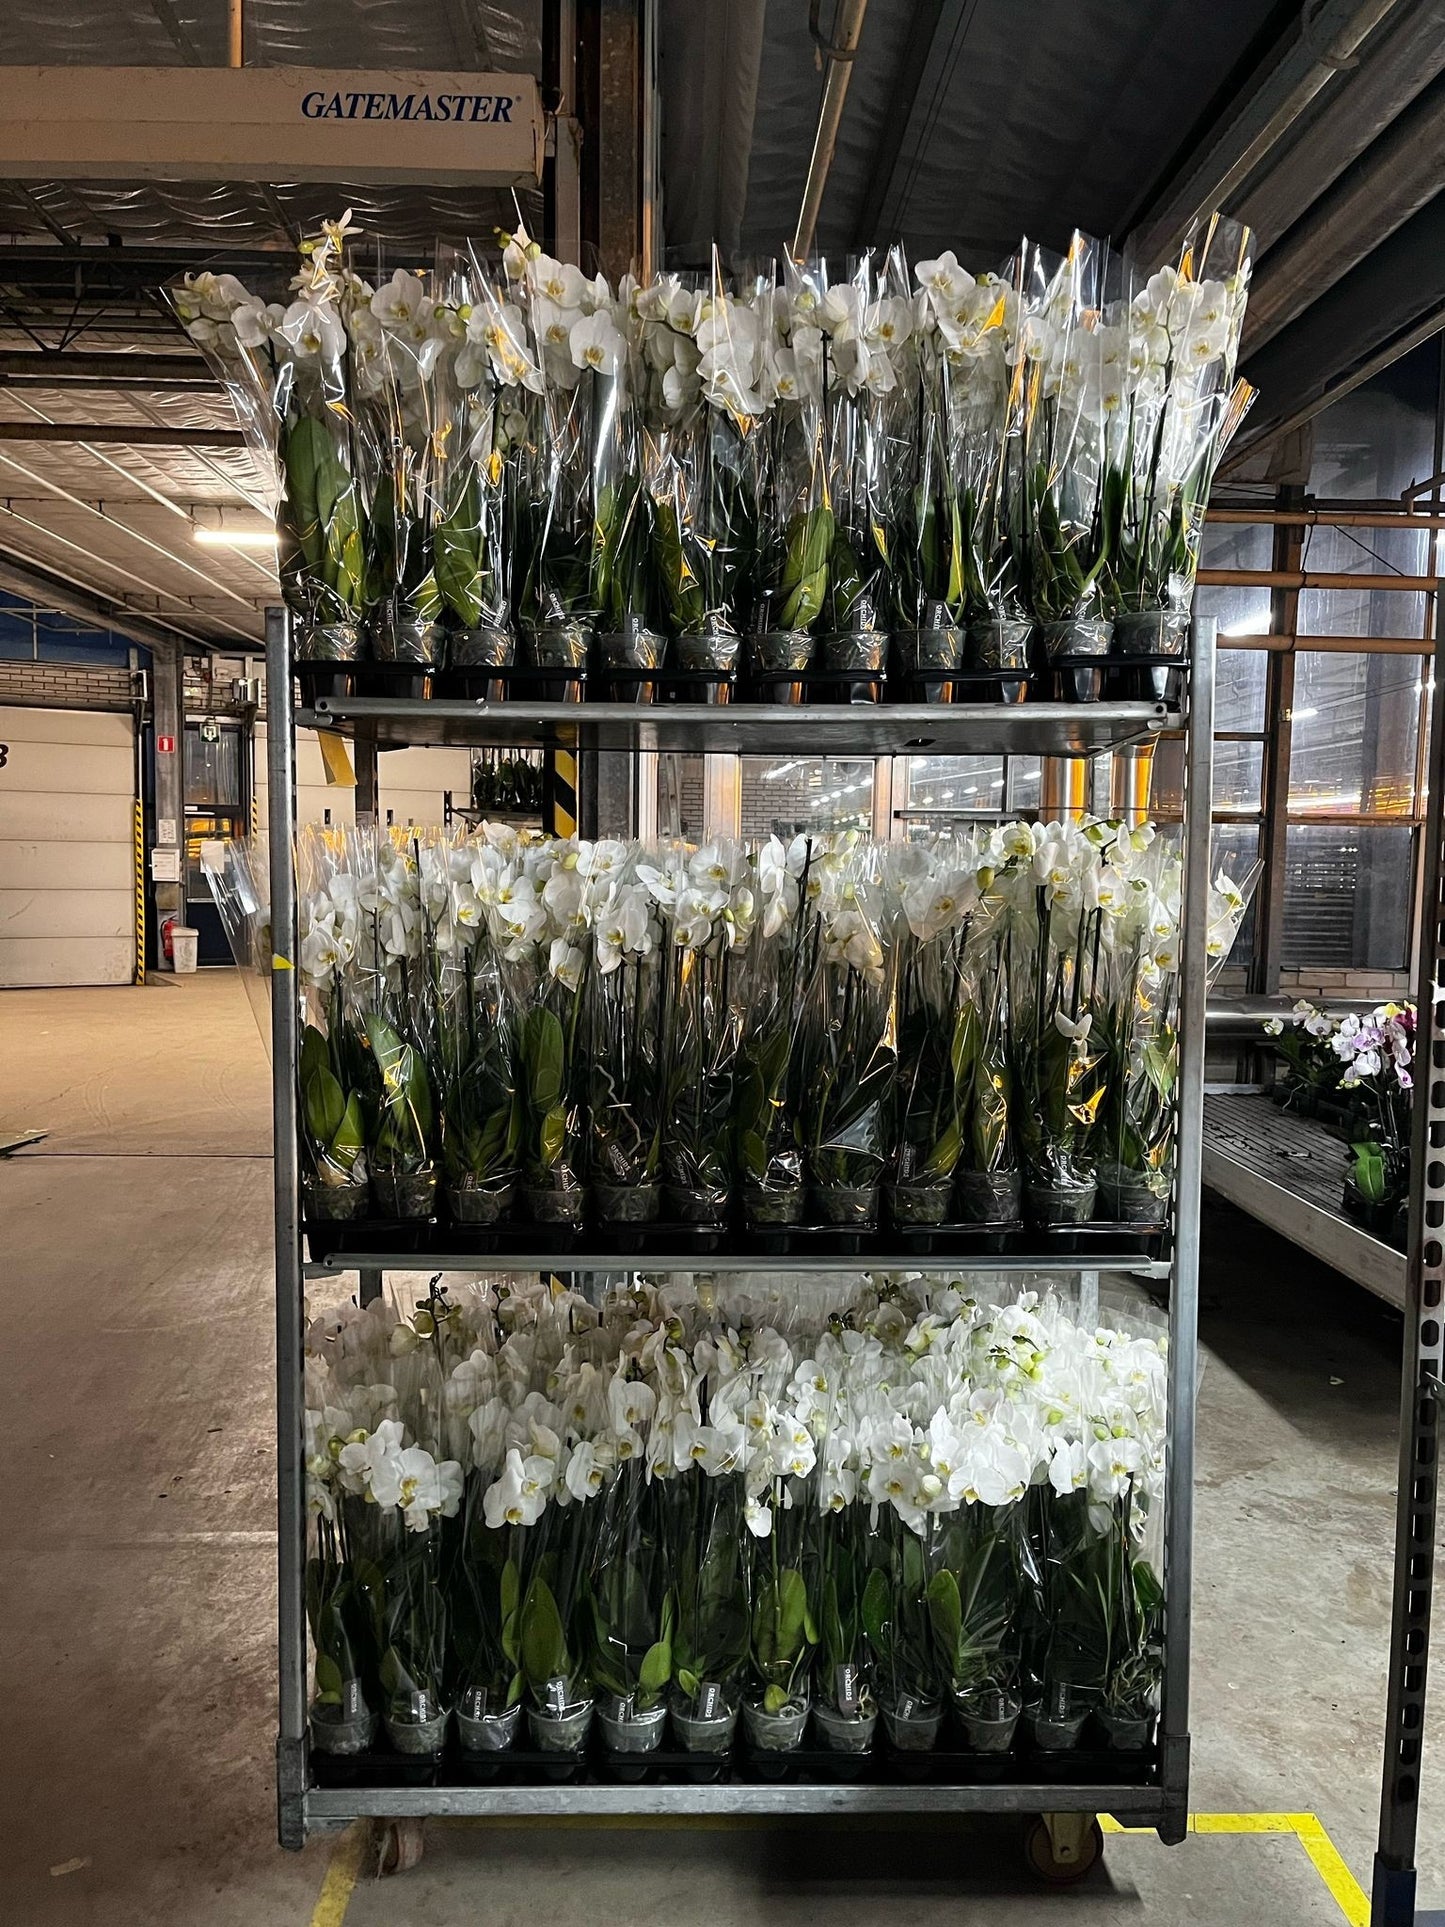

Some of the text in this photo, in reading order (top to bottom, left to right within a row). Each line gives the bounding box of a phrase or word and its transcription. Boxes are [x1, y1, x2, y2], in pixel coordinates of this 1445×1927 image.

[301, 92, 513, 122] GATEMASTER
[610, 1144, 631, 1172] ORCHIDS
[844, 1668, 853, 1701] ORCHIDS
[704, 1687, 716, 1718] ORCHIDS
